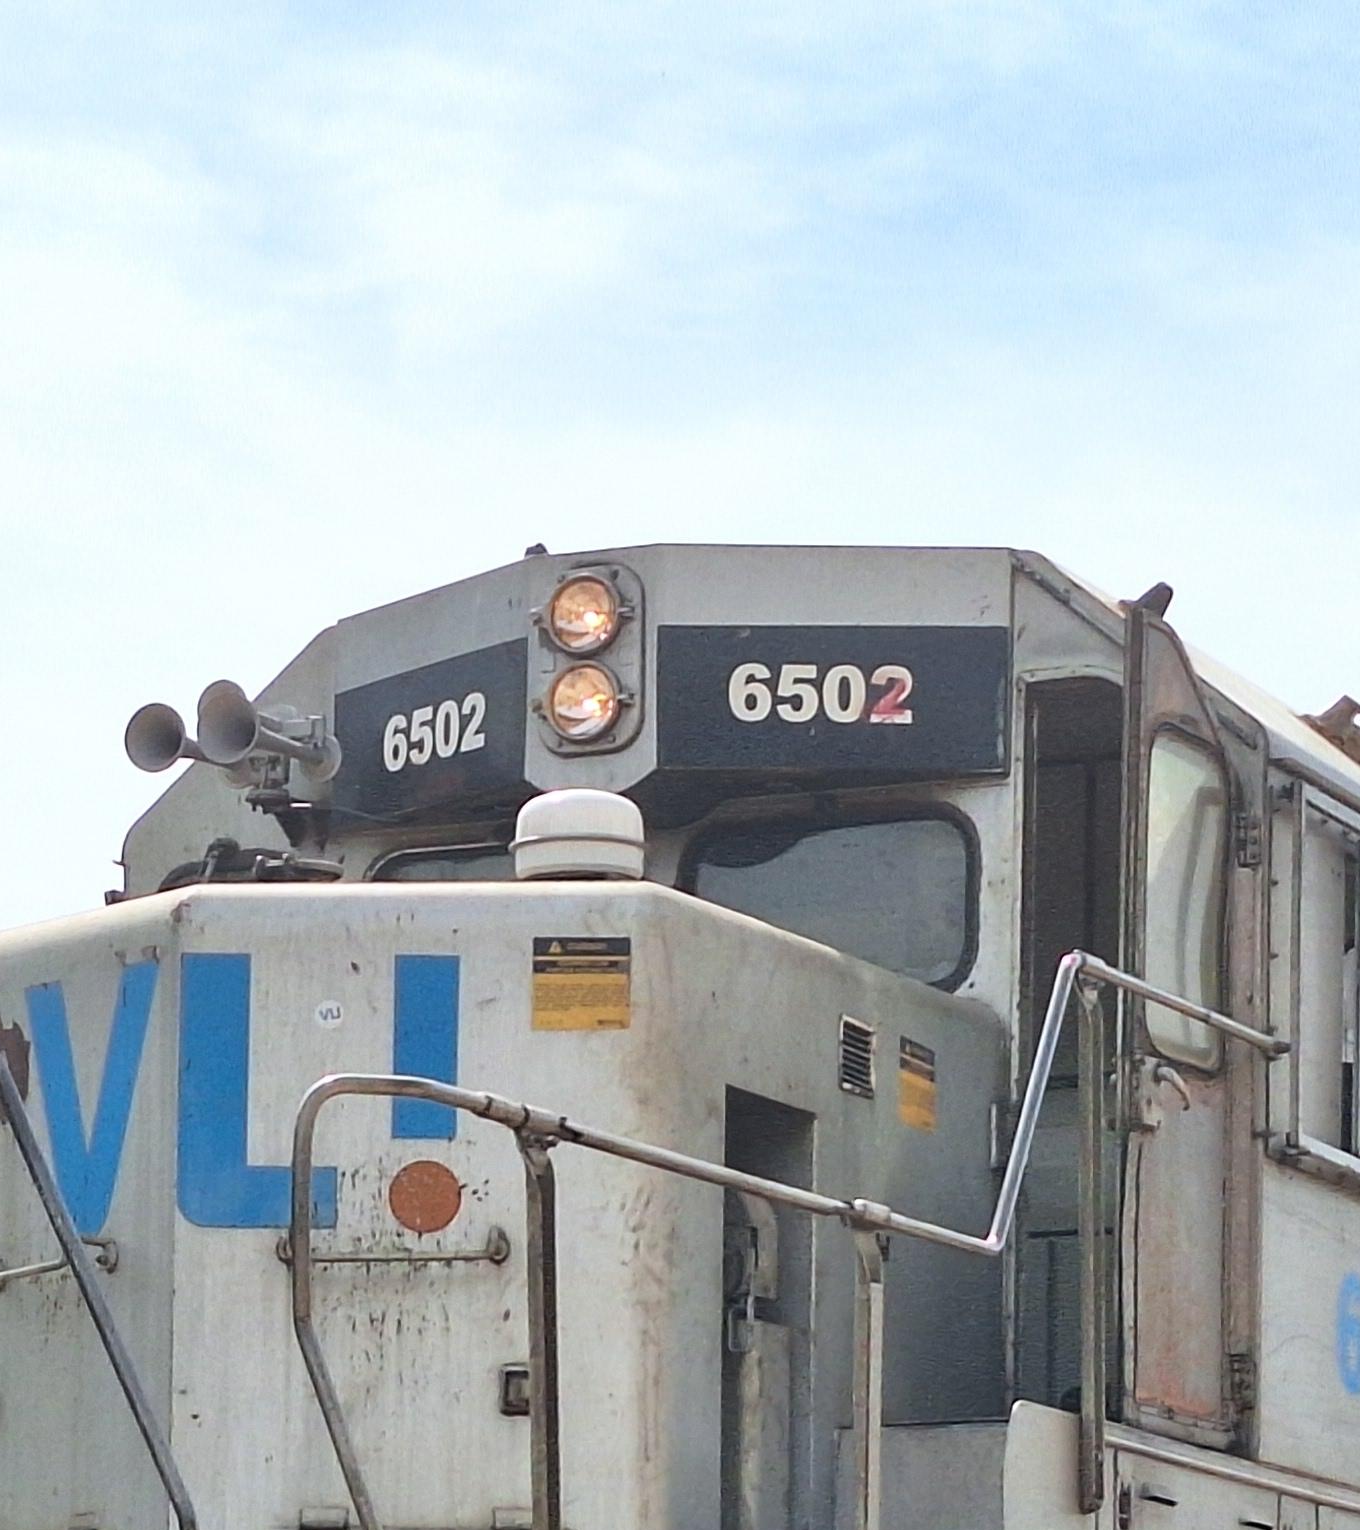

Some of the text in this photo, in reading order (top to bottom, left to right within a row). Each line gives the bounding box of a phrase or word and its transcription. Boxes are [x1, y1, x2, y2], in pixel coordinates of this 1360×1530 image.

[382, 692, 487, 773] 6502
[728, 663, 914, 725] 6502
[25, 953, 460, 1234] VLI
